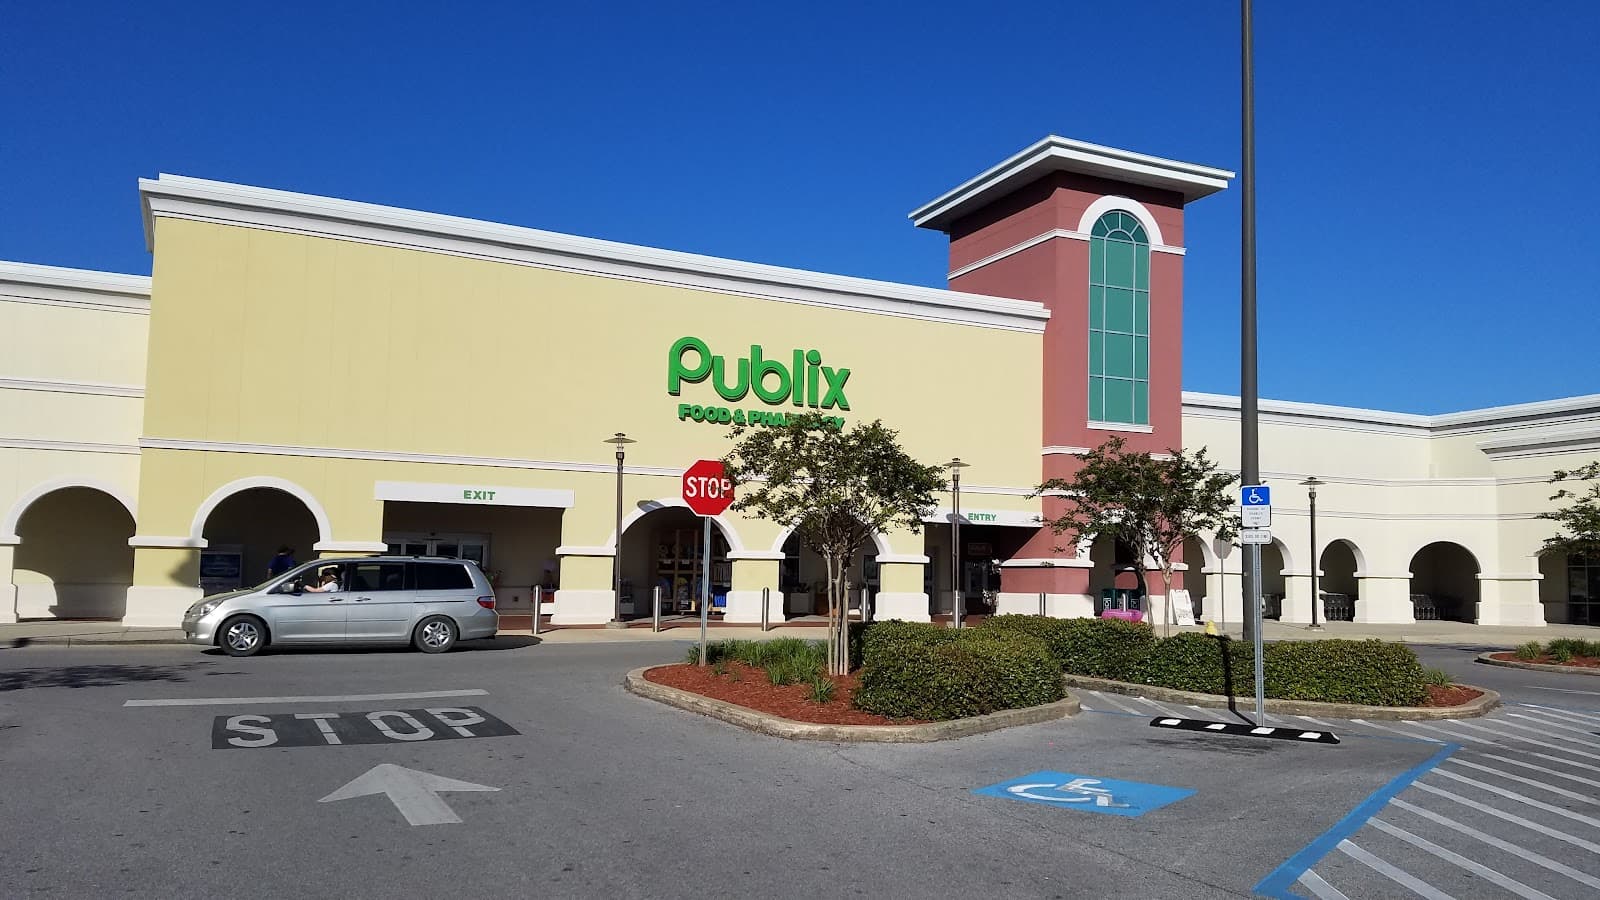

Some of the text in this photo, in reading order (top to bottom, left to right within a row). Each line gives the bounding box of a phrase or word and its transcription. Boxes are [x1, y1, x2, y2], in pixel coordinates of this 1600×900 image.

[668, 337, 850, 411] Publix
[678, 403, 731, 424] FOOD
[732, 408, 748, 426] &
[463, 489, 496, 501] EXIT
[685, 476, 731, 499] STOP
[967, 512, 997, 522] ENTRY
[225, 707, 486, 748] STOP
